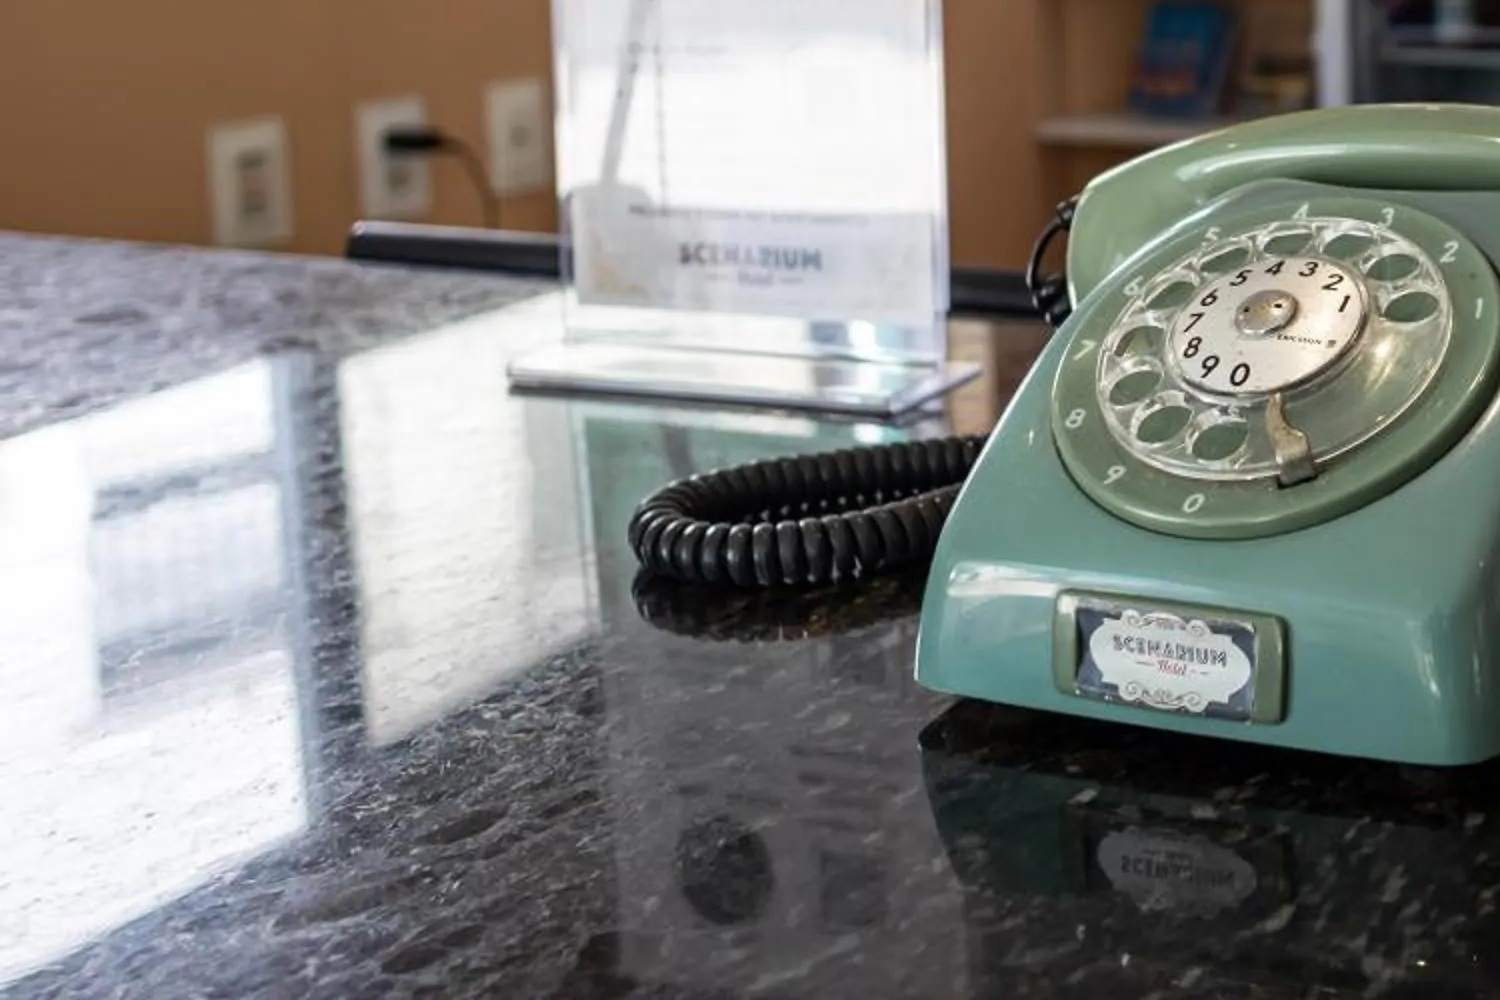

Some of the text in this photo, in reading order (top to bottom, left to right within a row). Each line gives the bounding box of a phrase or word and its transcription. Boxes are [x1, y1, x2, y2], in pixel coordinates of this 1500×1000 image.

[1380, 207, 1395, 226] 3
[1442, 240, 1459, 263] 2
[1183, 260, 1351, 387] 1 2 3 4 5 6 7 8 9 0
[1073, 340, 1094, 361] 7
[1065, 409, 1086, 429] 8
[1103, 465, 1127, 485] 9
[1182, 493, 1205, 513] 0
[1112, 634, 1228, 669] SCENARIUM
